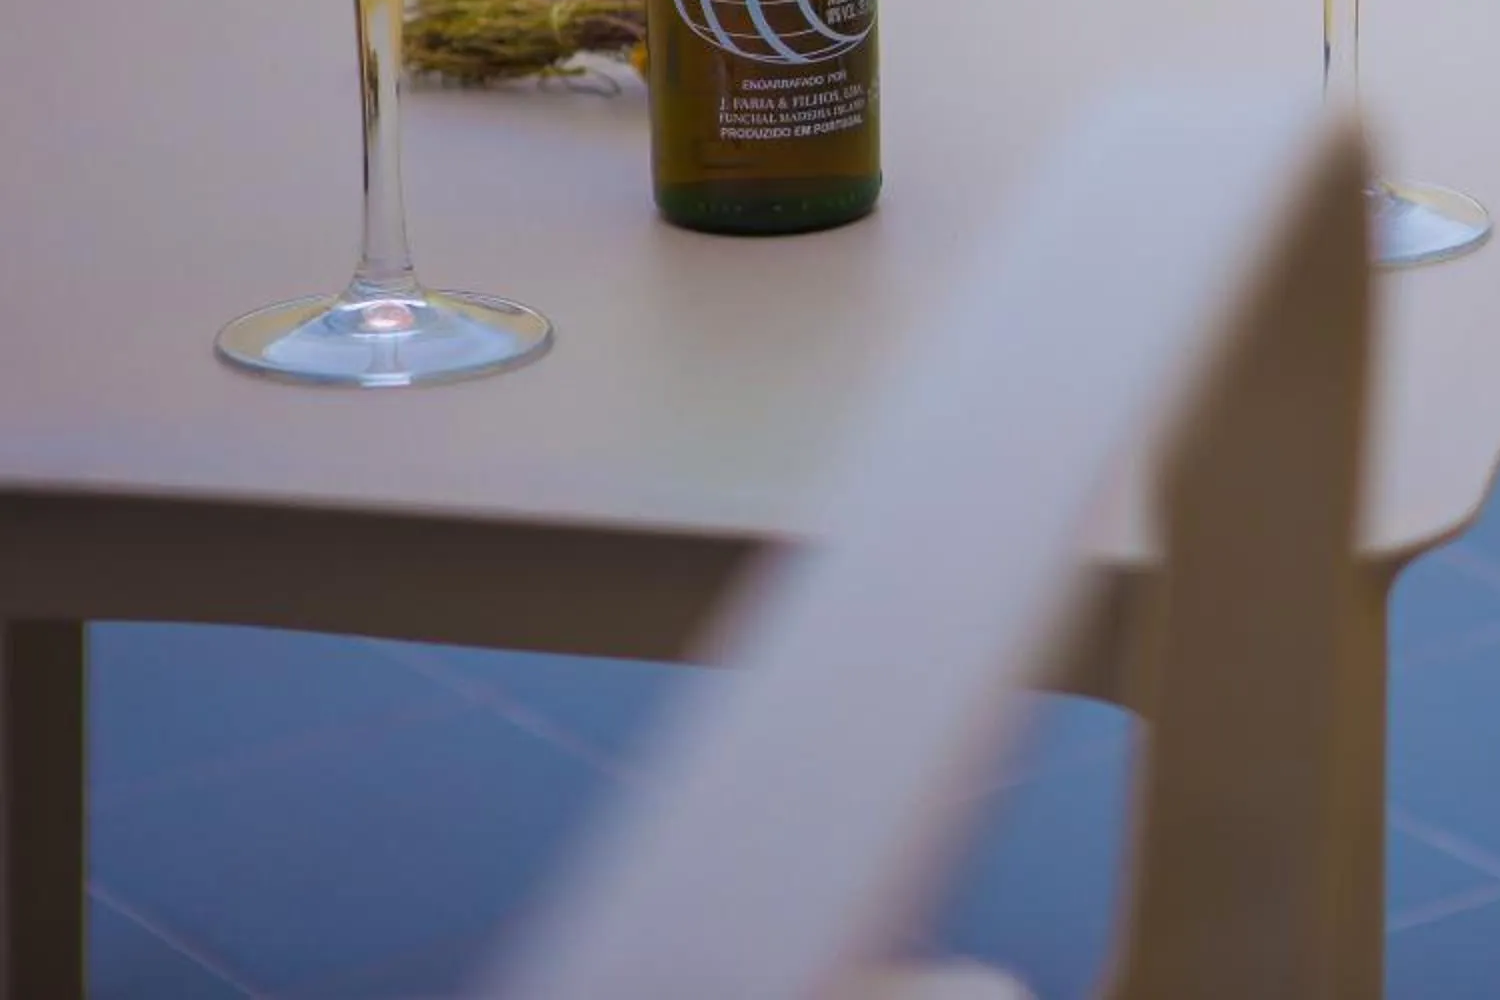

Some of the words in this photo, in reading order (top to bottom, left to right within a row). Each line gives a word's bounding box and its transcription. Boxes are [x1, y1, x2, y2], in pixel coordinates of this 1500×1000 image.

[733, 96, 775, 111] FARIA
[777, 97, 788, 110] &
[720, 125, 791, 140] PRODUZIDO
[794, 124, 812, 137] EM
